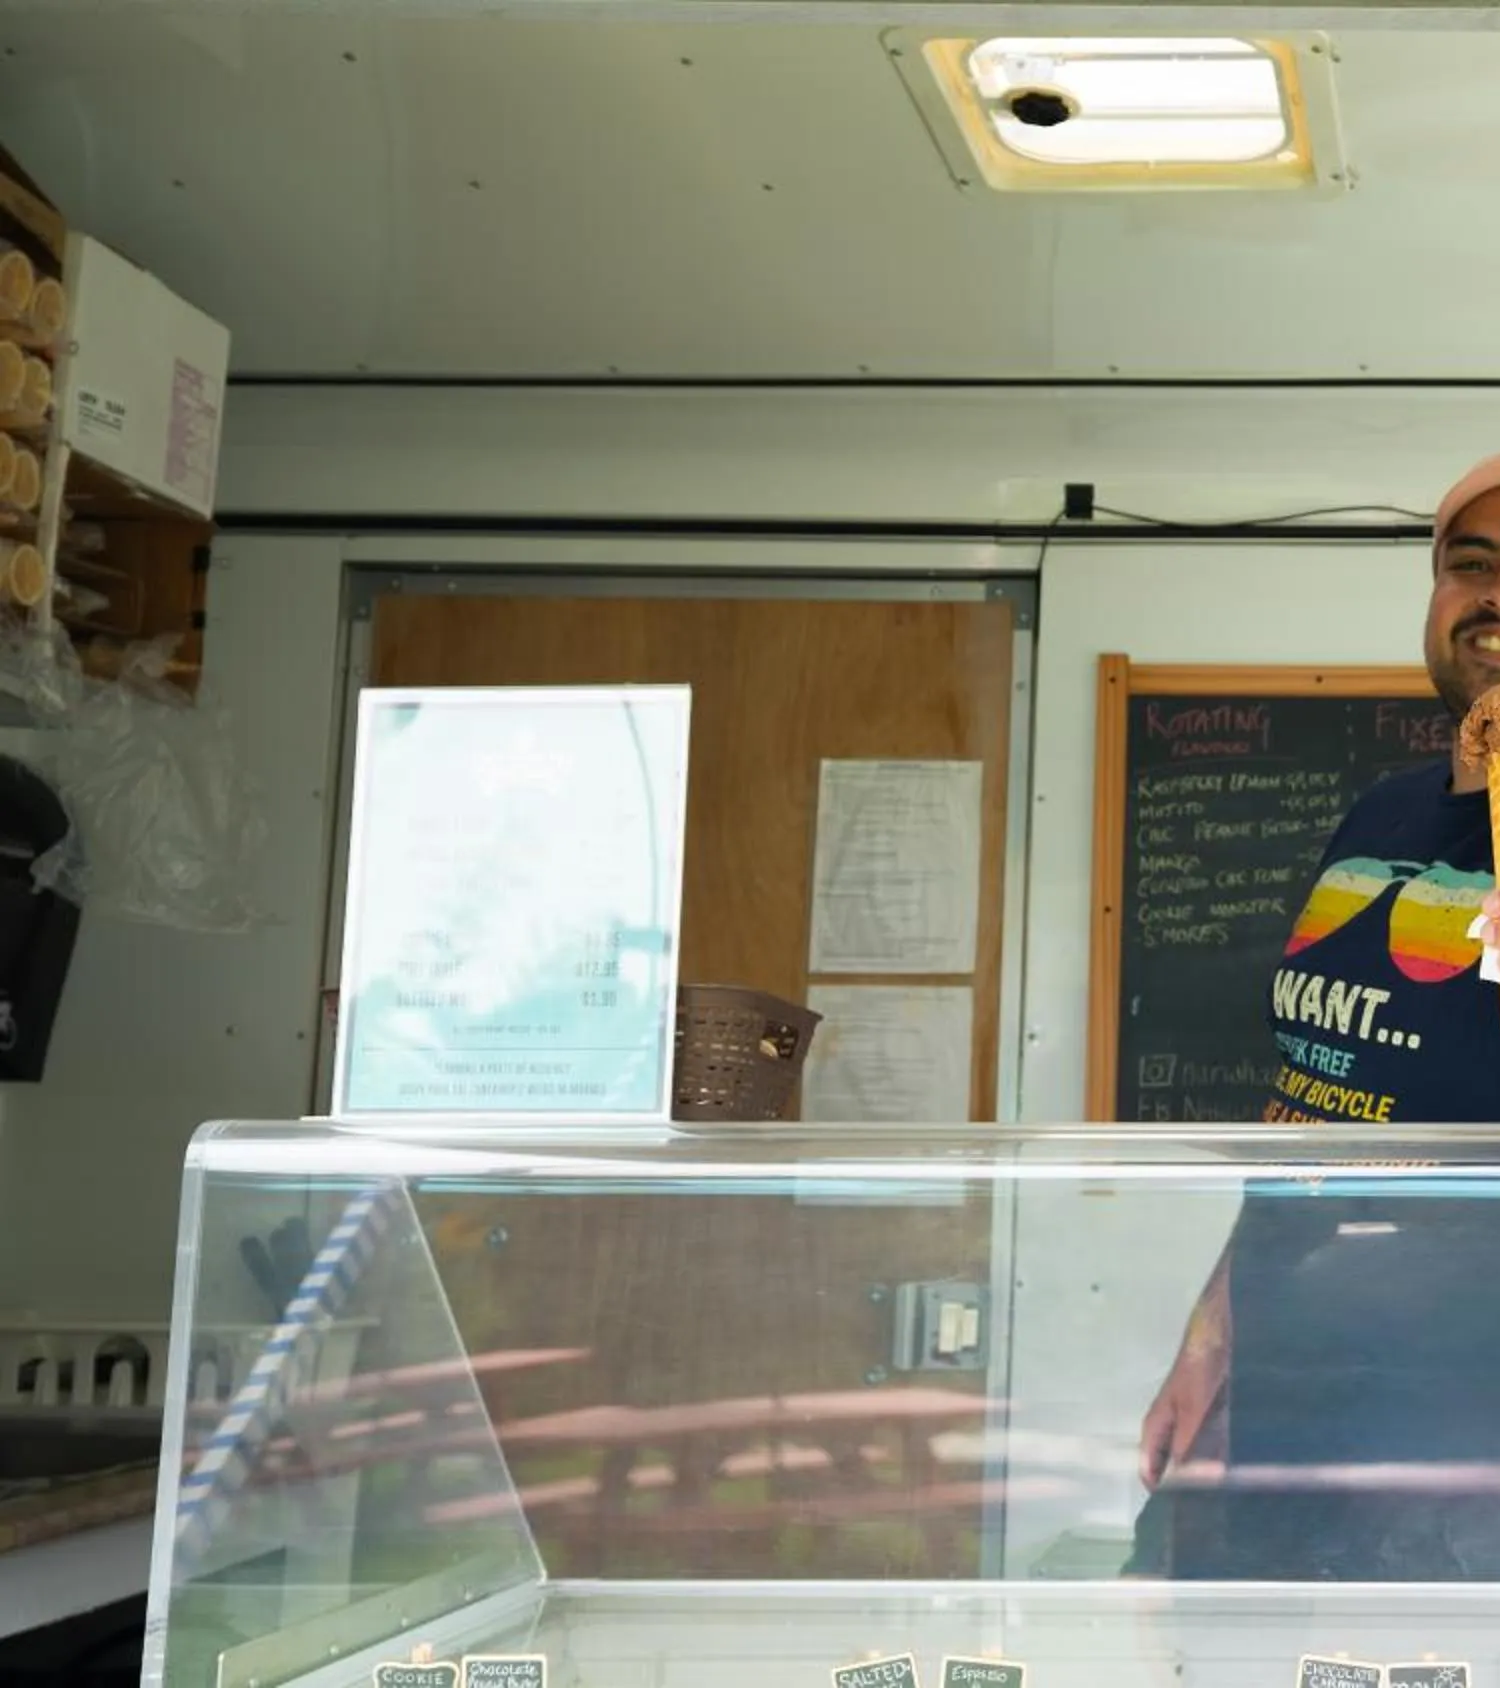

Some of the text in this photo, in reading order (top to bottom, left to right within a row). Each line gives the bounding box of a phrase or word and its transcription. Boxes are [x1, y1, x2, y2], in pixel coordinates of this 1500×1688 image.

[1146, 701, 1271, 752] ROTATING
[1375, 702, 1451, 741] FIXE
[1309, 1043, 1357, 1079] FREE
[1304, 1078, 1396, 1123] BICYCLE
[382, 1669, 445, 1686] COOKIE
